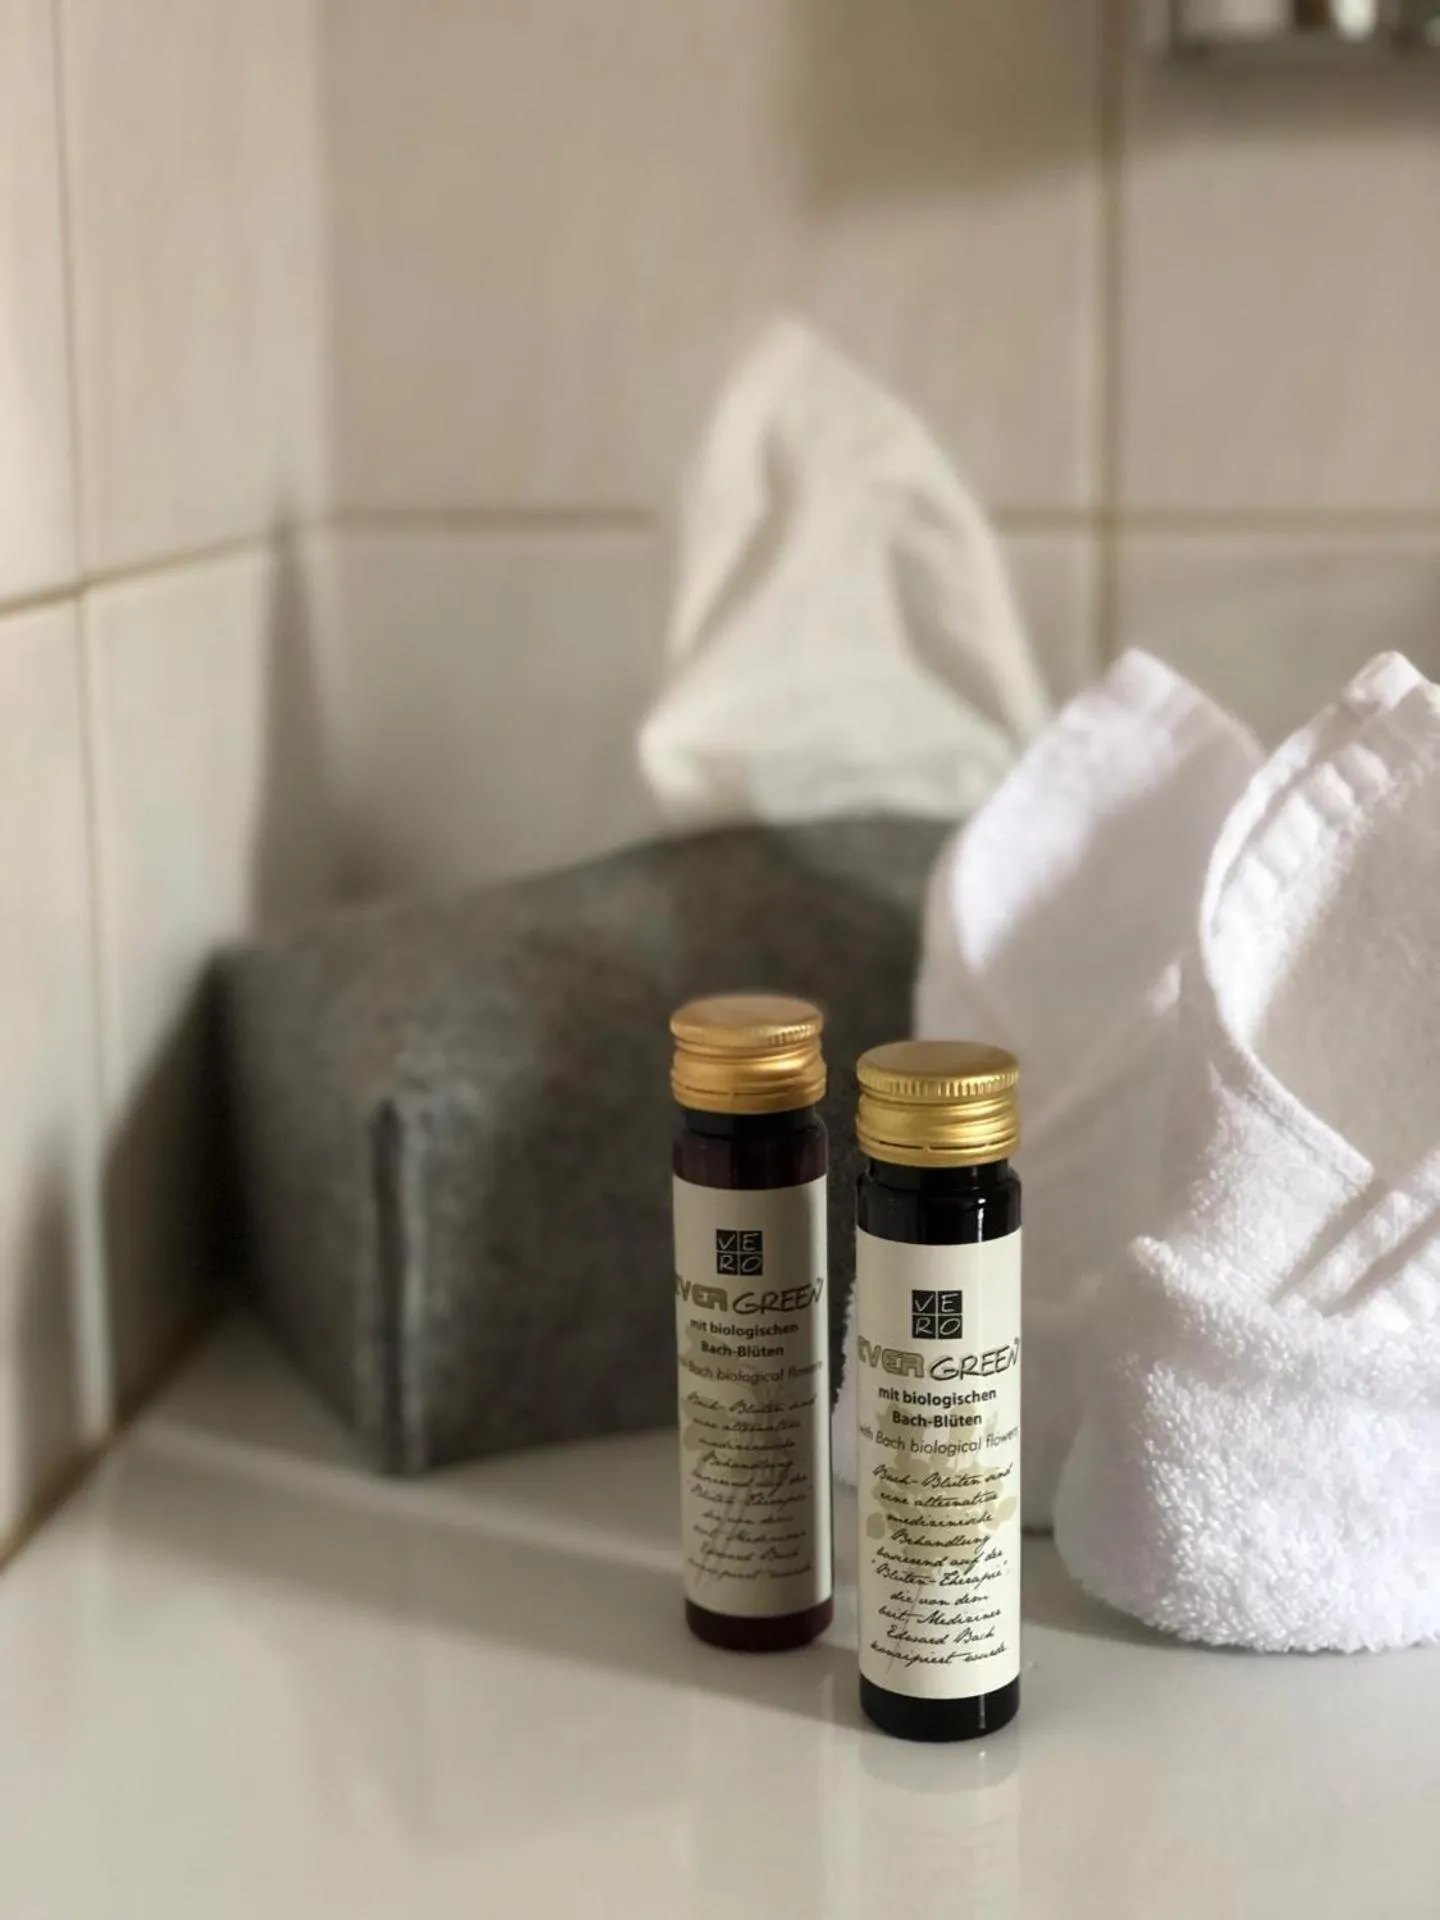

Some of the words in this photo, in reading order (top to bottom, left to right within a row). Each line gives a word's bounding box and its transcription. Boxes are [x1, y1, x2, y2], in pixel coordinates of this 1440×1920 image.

[733, 1276, 824, 1315] GREEN
[690, 1319, 707, 1332] mit
[710, 1321, 799, 1339] biologischen
[701, 1340, 784, 1358] Bach-Blüten
[929, 1336, 1020, 1381] GREEN
[716, 1367, 784, 1385] biological
[878, 1387, 900, 1401] mit
[902, 1389, 997, 1409] biologischen
[892, 1410, 982, 1428] Bach-Blüten
[876, 1430, 905, 1450] Bach
[910, 1437, 982, 1457] biological
[953, 1625, 995, 1644] Bach
